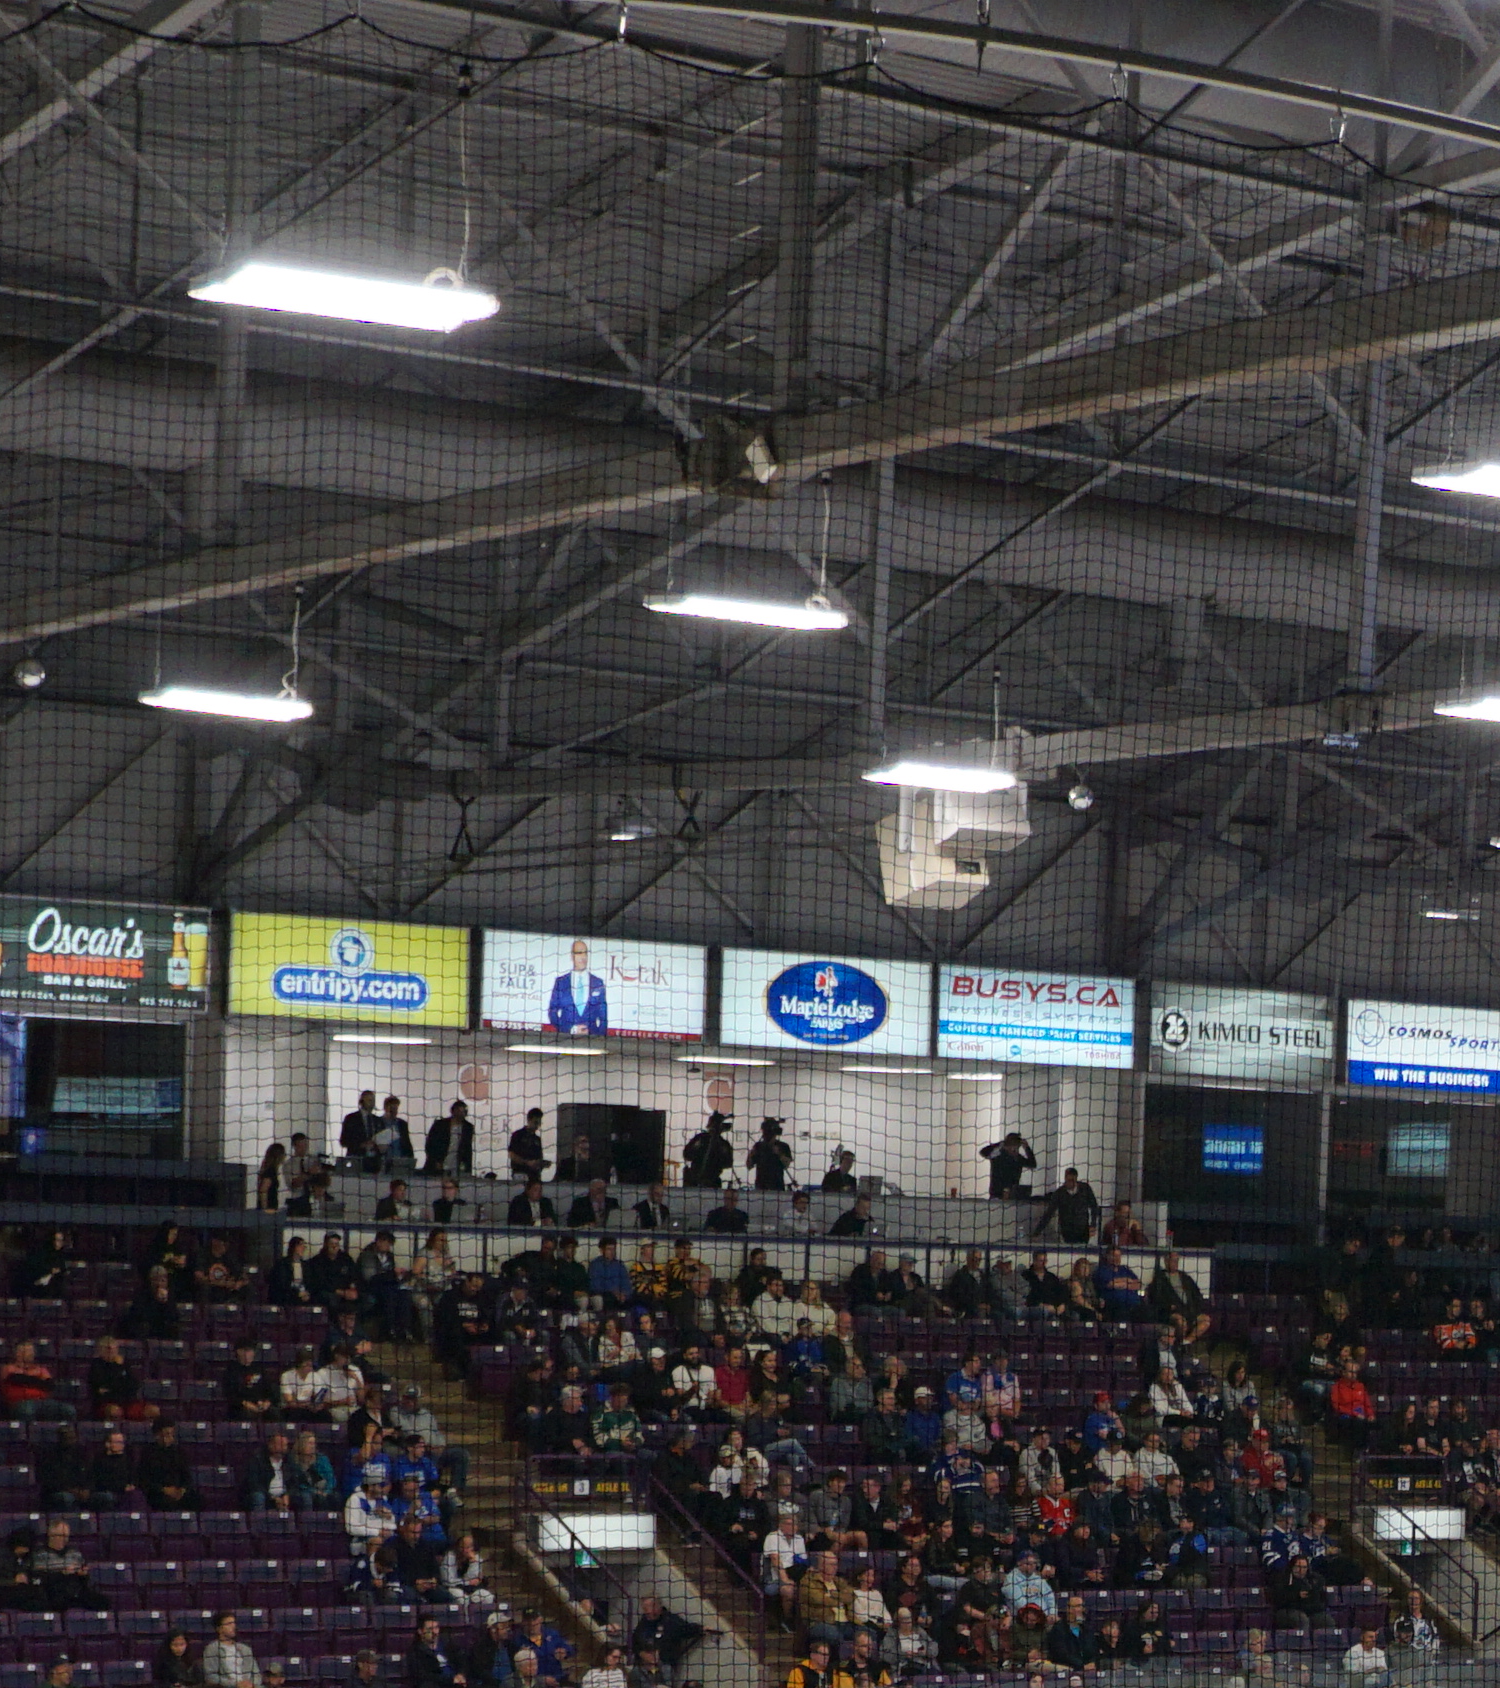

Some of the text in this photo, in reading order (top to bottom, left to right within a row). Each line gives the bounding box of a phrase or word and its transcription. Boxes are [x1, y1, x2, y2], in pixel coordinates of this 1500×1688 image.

[27, 907, 145, 959] Oscar's
[27, 953, 145, 979] ROADHOUSE
[43, 975, 71, 987] BAR
[87, 977, 128, 990] GRILL
[280, 968, 421, 1003] entripy.com
[952, 976, 1120, 1008] BUSYS.CA
[1198, 1021, 1326, 1049] KIMCO STEEL
[1387, 1025, 1452, 1041] COSMOS
[1374, 1068, 1489, 1087] WIN THE BUSINESS
